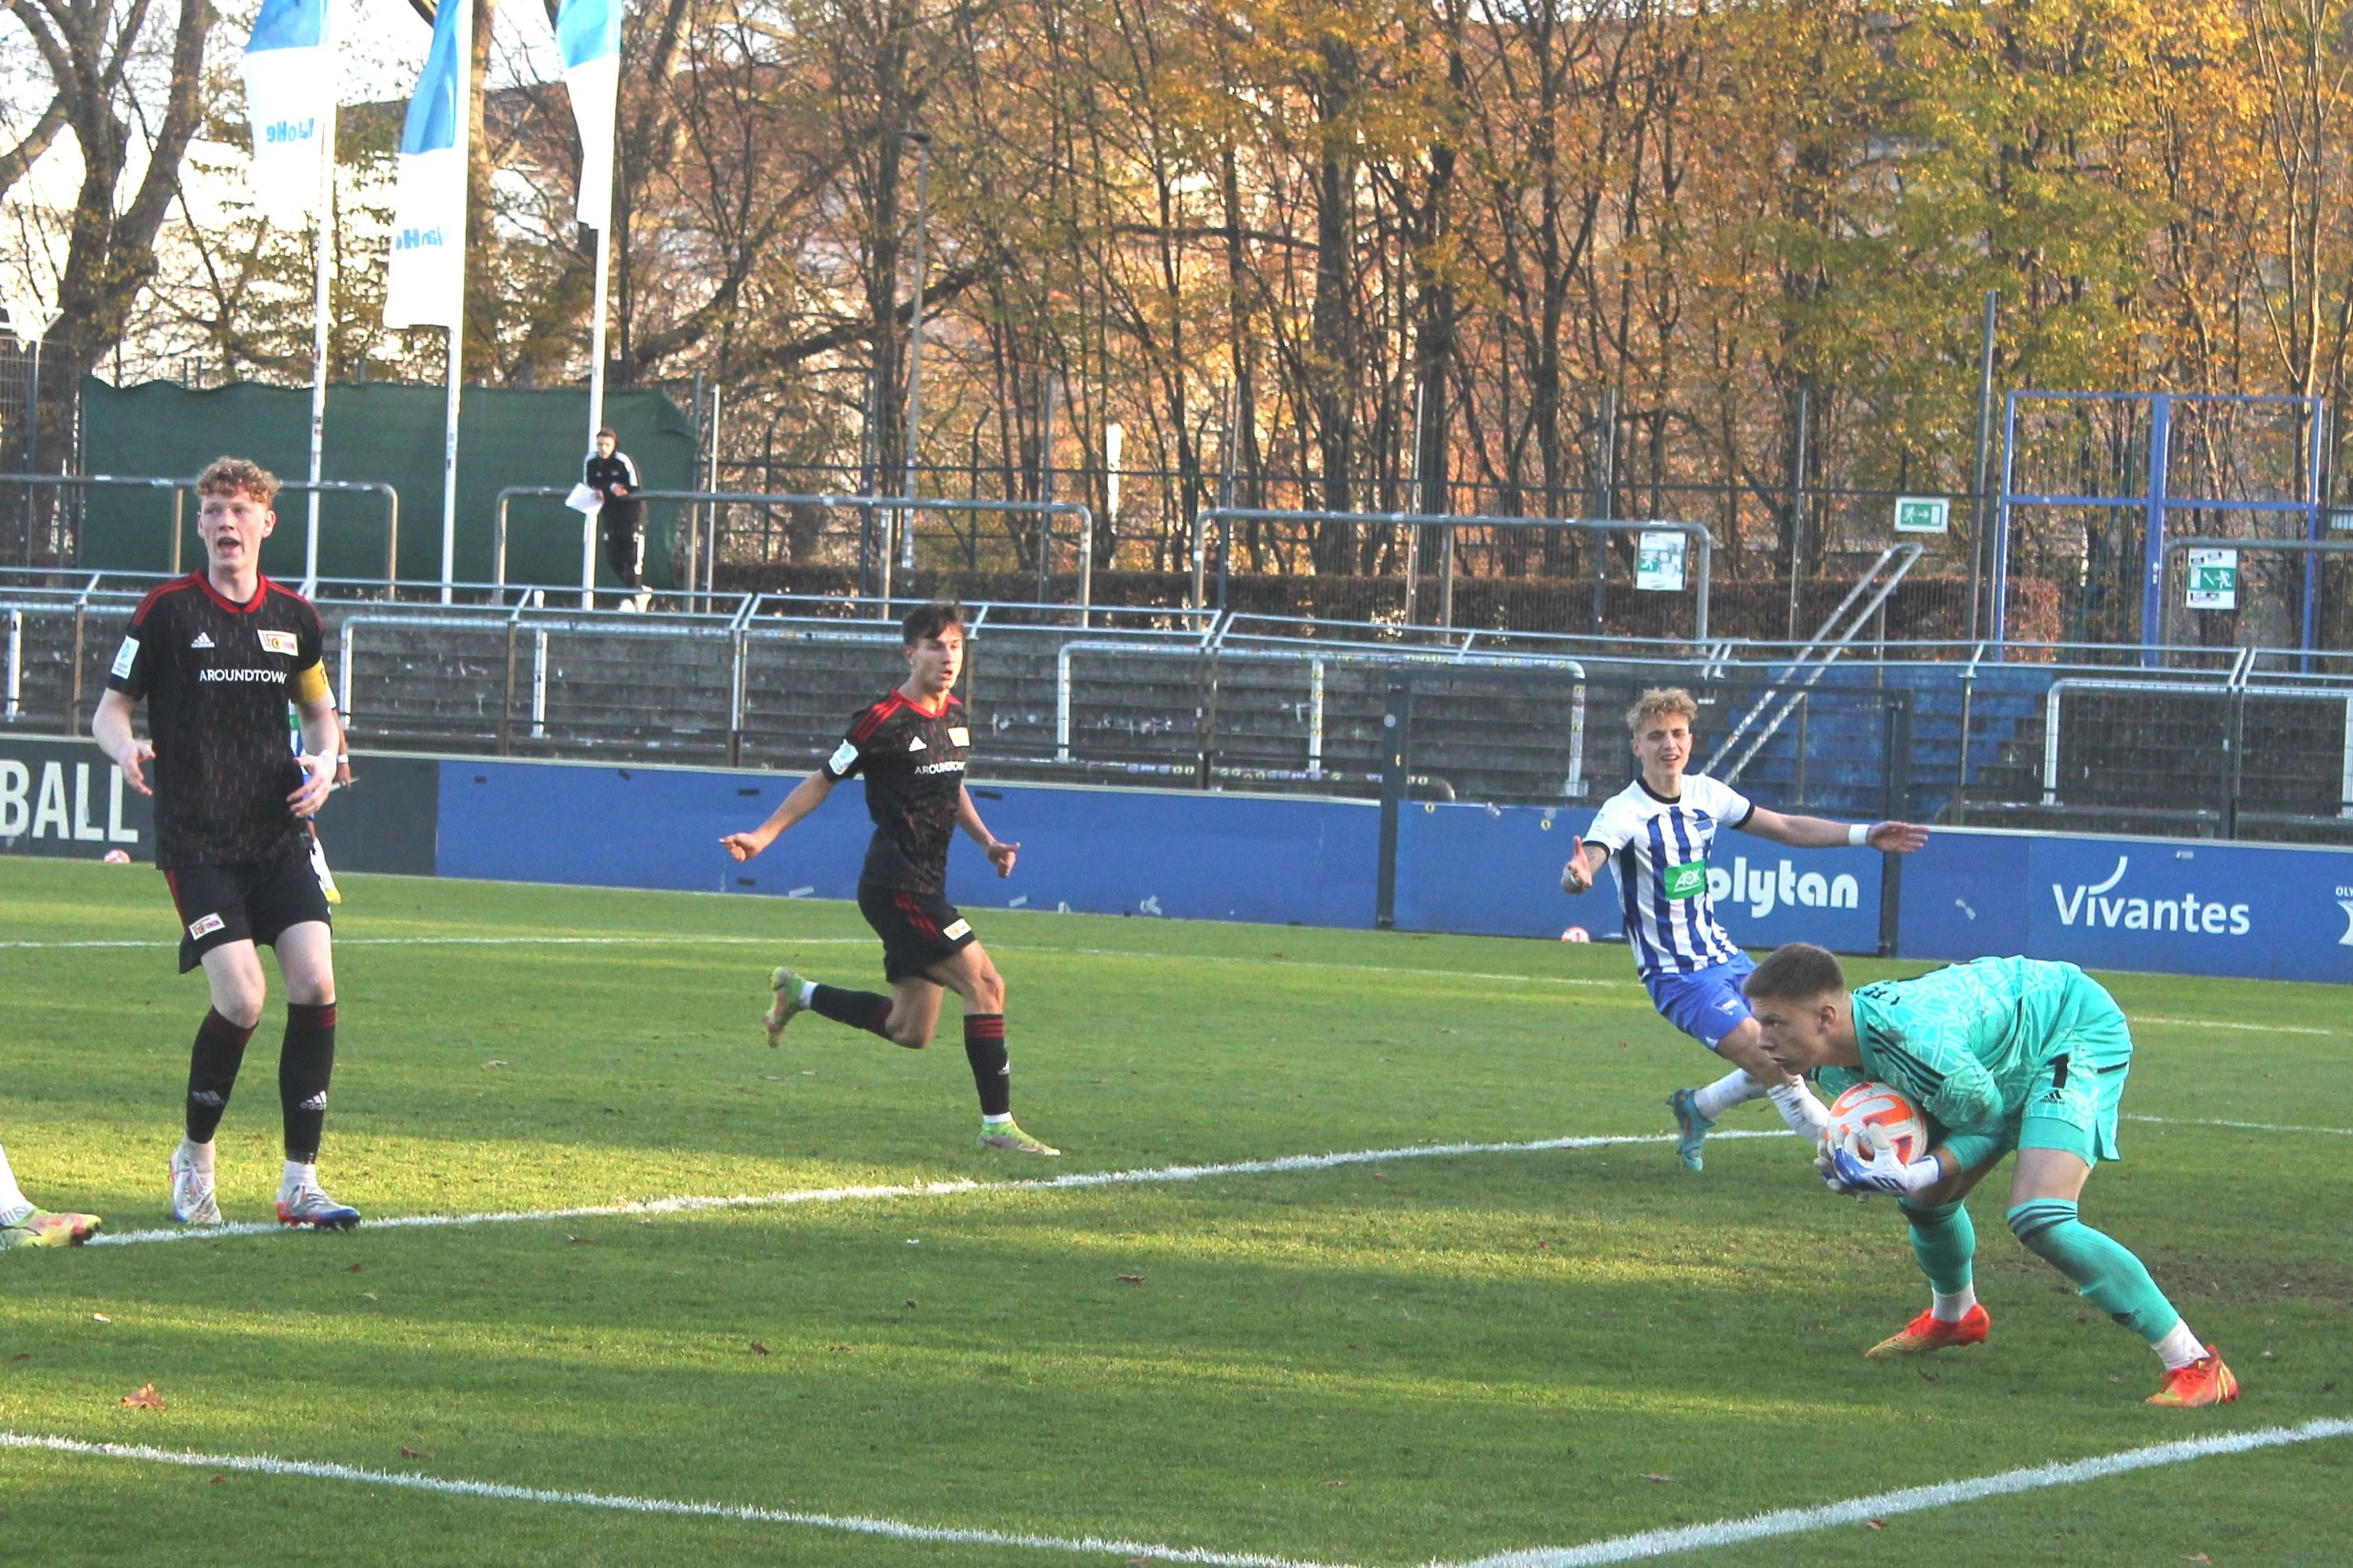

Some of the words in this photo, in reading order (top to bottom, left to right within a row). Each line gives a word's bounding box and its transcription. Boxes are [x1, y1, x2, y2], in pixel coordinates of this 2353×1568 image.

[1674, 868, 1701, 888] AOK
[1705, 856, 1859, 918] olytan
[2052, 856, 2251, 936] Vivantes
[2044, 1053, 2069, 1089] 1
